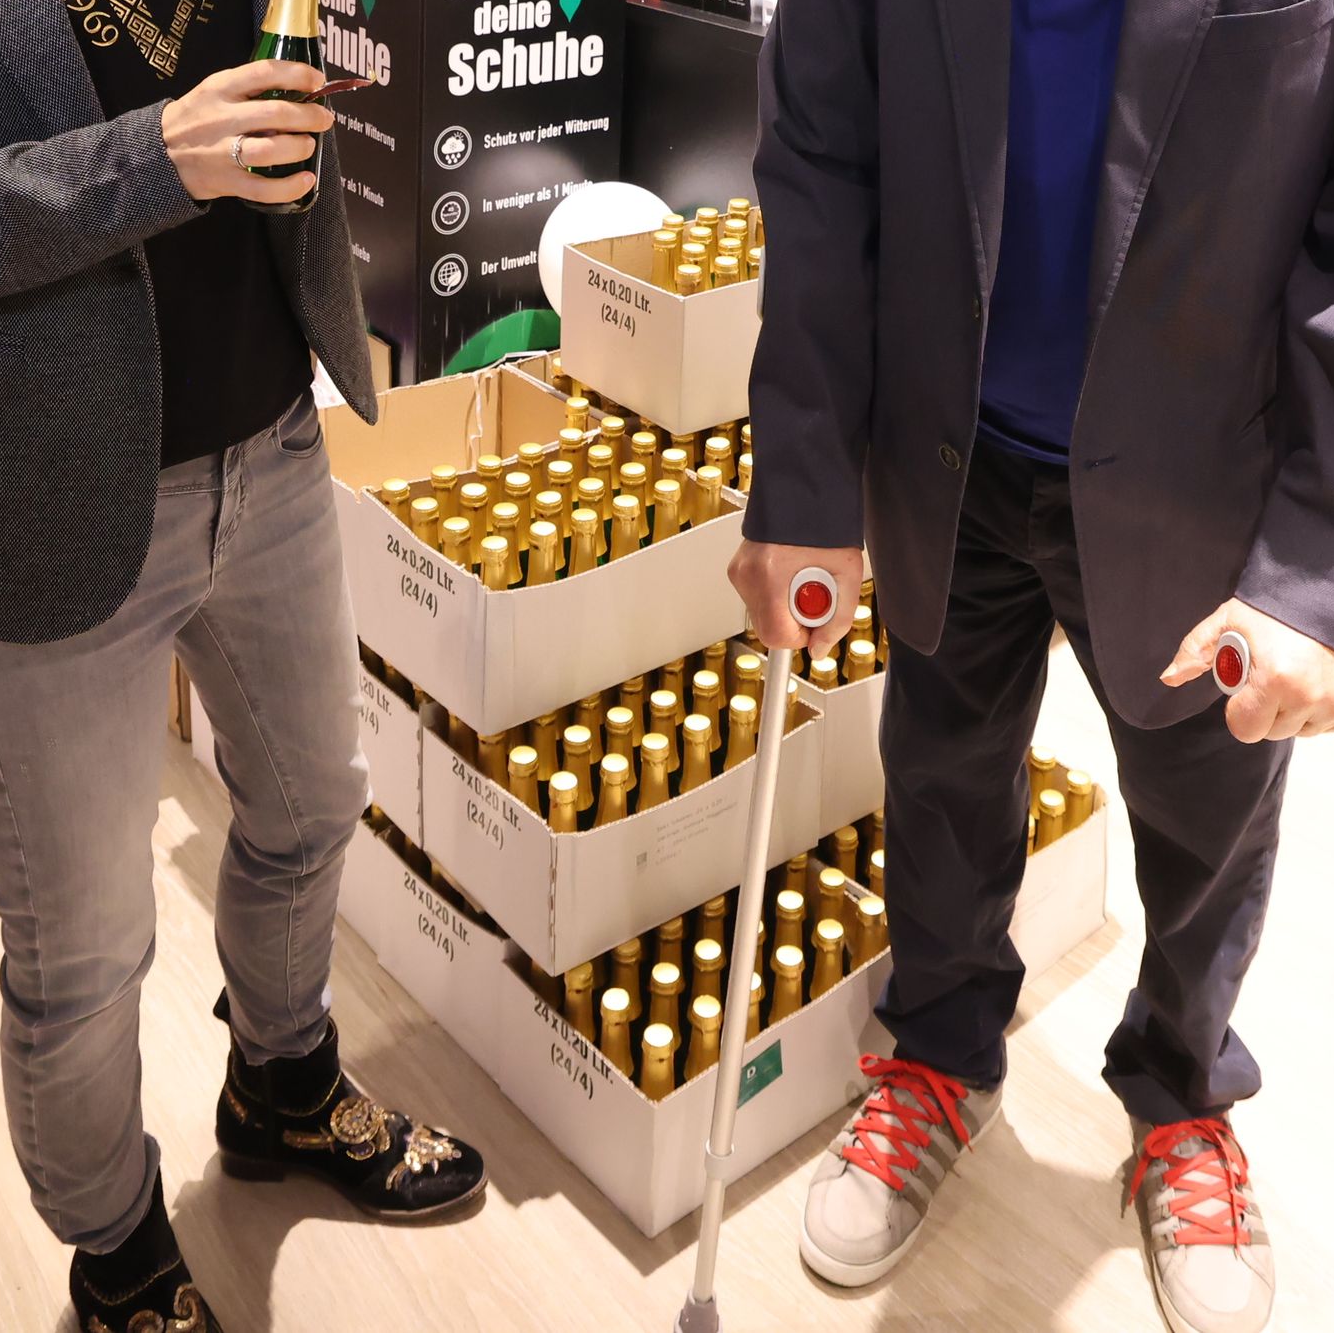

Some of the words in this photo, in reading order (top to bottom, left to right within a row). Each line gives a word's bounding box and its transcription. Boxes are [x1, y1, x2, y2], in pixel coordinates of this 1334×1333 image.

[318, 12, 392, 87] chuhe
[447, 33, 605, 97] Schuhe
[336, 112, 346, 125] vor
[347, 113, 364, 137] jeder
[364, 122, 396, 153] Witterung
[484, 129, 517, 149] Schutz
[519, 129, 535, 143] vor
[537, 123, 563, 144] jeder
[565, 117, 610, 135] Witterung
[347, 179, 357, 193] als
[357, 182, 362, 196] 1
[362, 184, 385, 208] Minute
[482, 198, 493, 213] In
[495, 190, 534, 211] weniger
[536, 188, 551, 202] als
[553, 185, 559, 198] 1
[481, 260, 499, 276] Der
[501, 251, 537, 272] Umwelt
[601, 302, 636, 337] (24/4)
[634, 290, 652, 315] Ltr.
[400, 572, 439, 618] (24/4)
[436, 567, 456, 595] Ltr.
[376, 688, 392, 716] Ltr.
[466, 803, 505, 851] (24/4)
[501, 798, 522, 831] Ltr.
[417, 914, 455, 962] (24/4)
[450, 914, 471, 946] Ltr.
[550, 1042, 594, 1100] (24/4)
[591, 1048, 614, 1085] Ltr.
